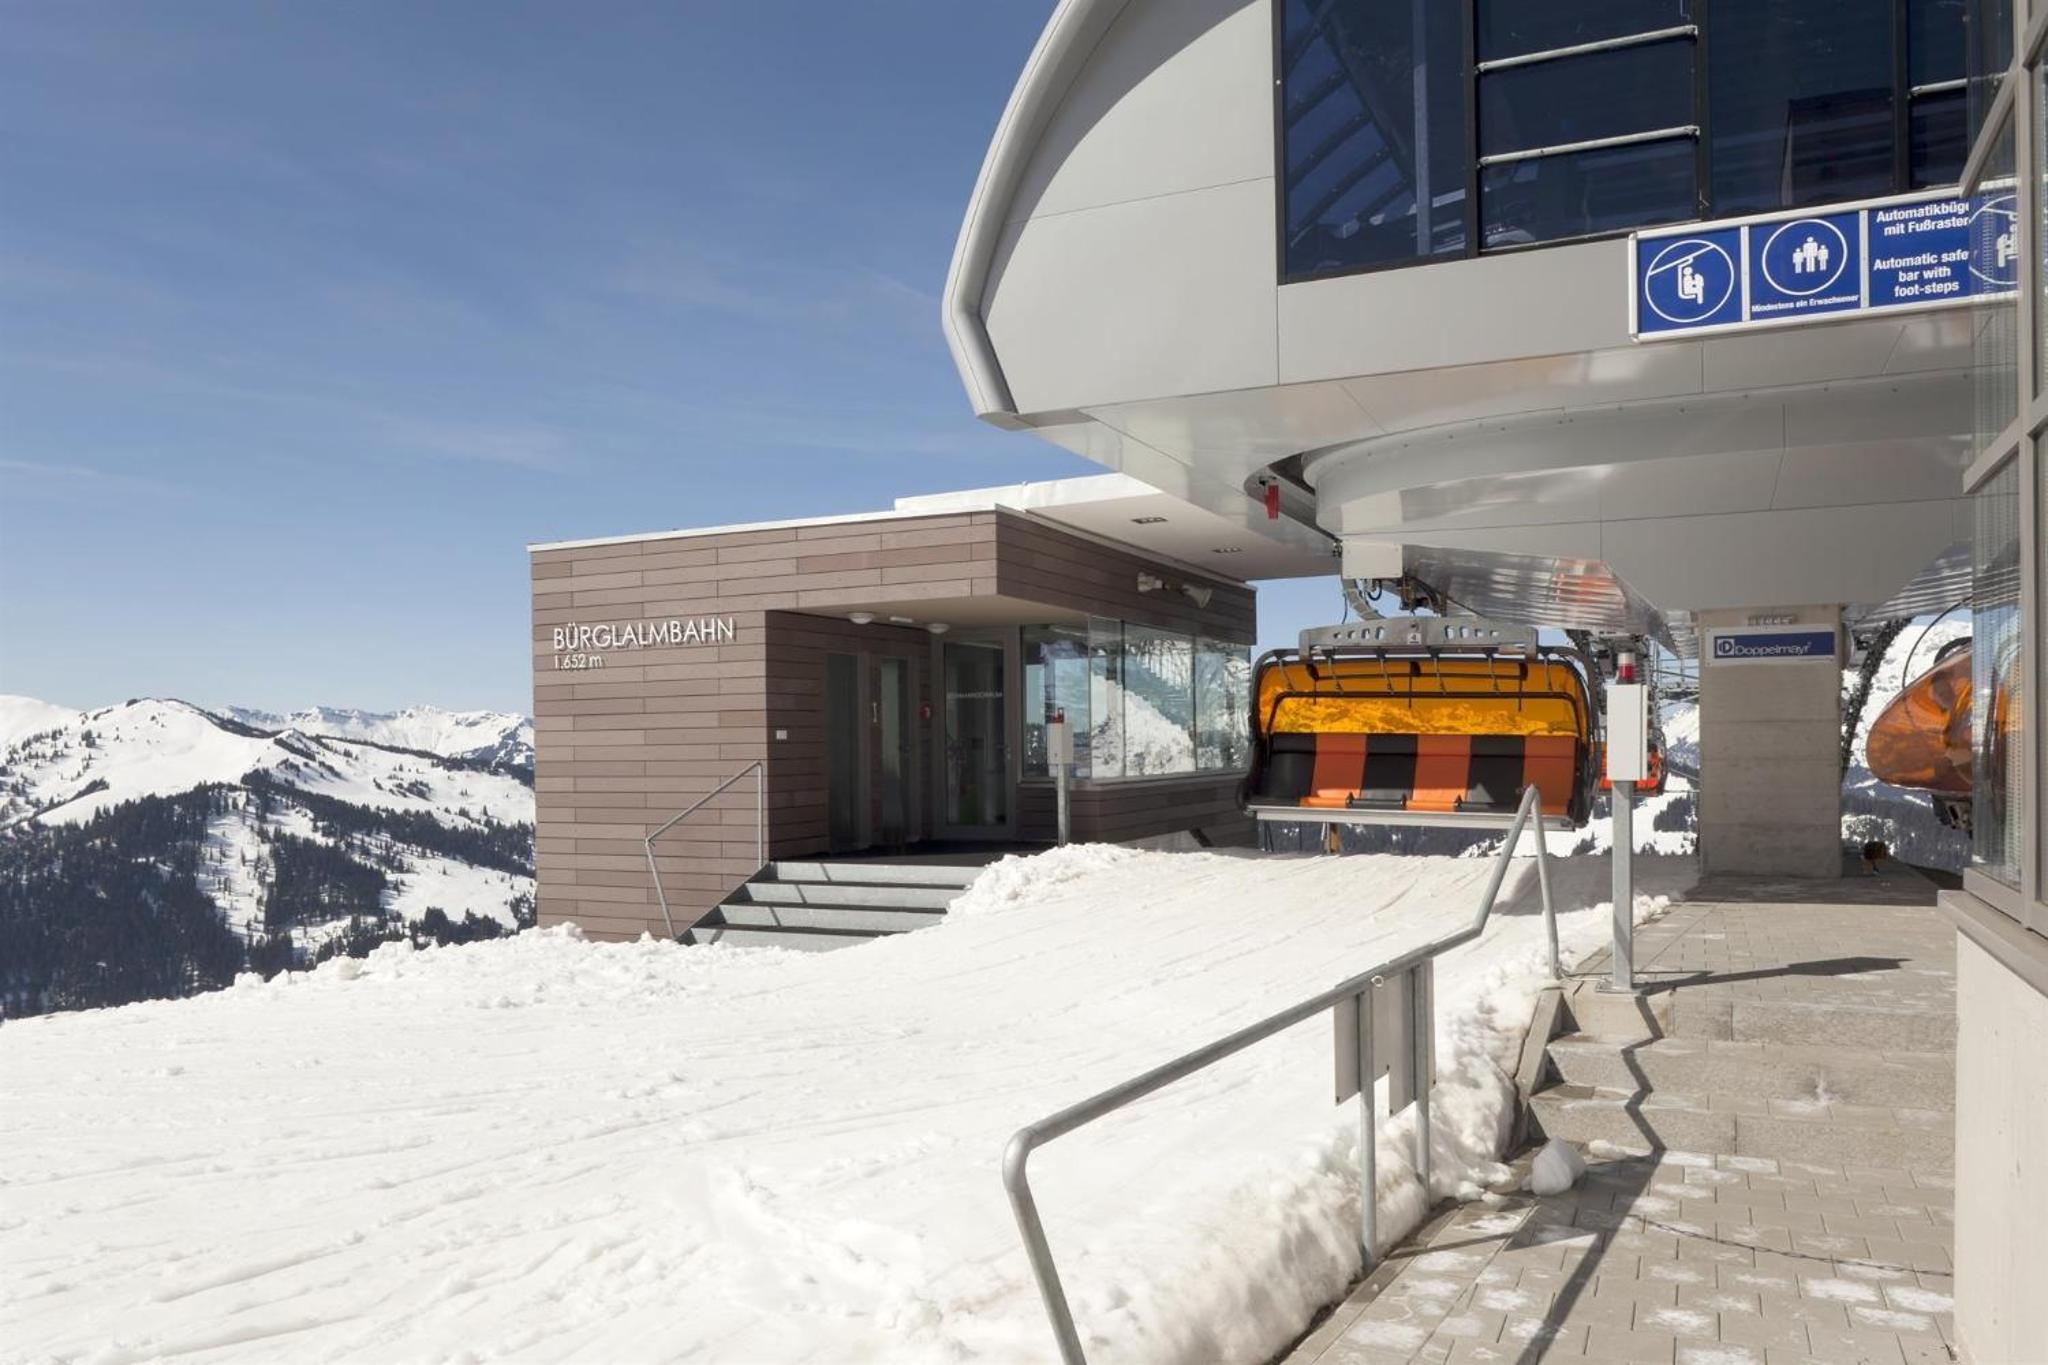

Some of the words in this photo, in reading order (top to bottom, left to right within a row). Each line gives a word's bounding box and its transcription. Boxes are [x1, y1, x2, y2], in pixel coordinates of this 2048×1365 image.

[1883, 223, 1905, 236] mit
[1873, 252, 1938, 271] Automatic
[1898, 270, 1920, 282] bar
[1922, 265, 1951, 279] with
[1894, 281, 1960, 297] foot-steps
[1751, 302, 1794, 312] Mindestens
[1796, 299, 1808, 308] ein
[1809, 295, 1859, 306] Erwachsener
[553, 616, 734, 650] BÜRGLALMBAHN
[554, 654, 586, 670] 1.652
[589, 655, 602, 667] m
